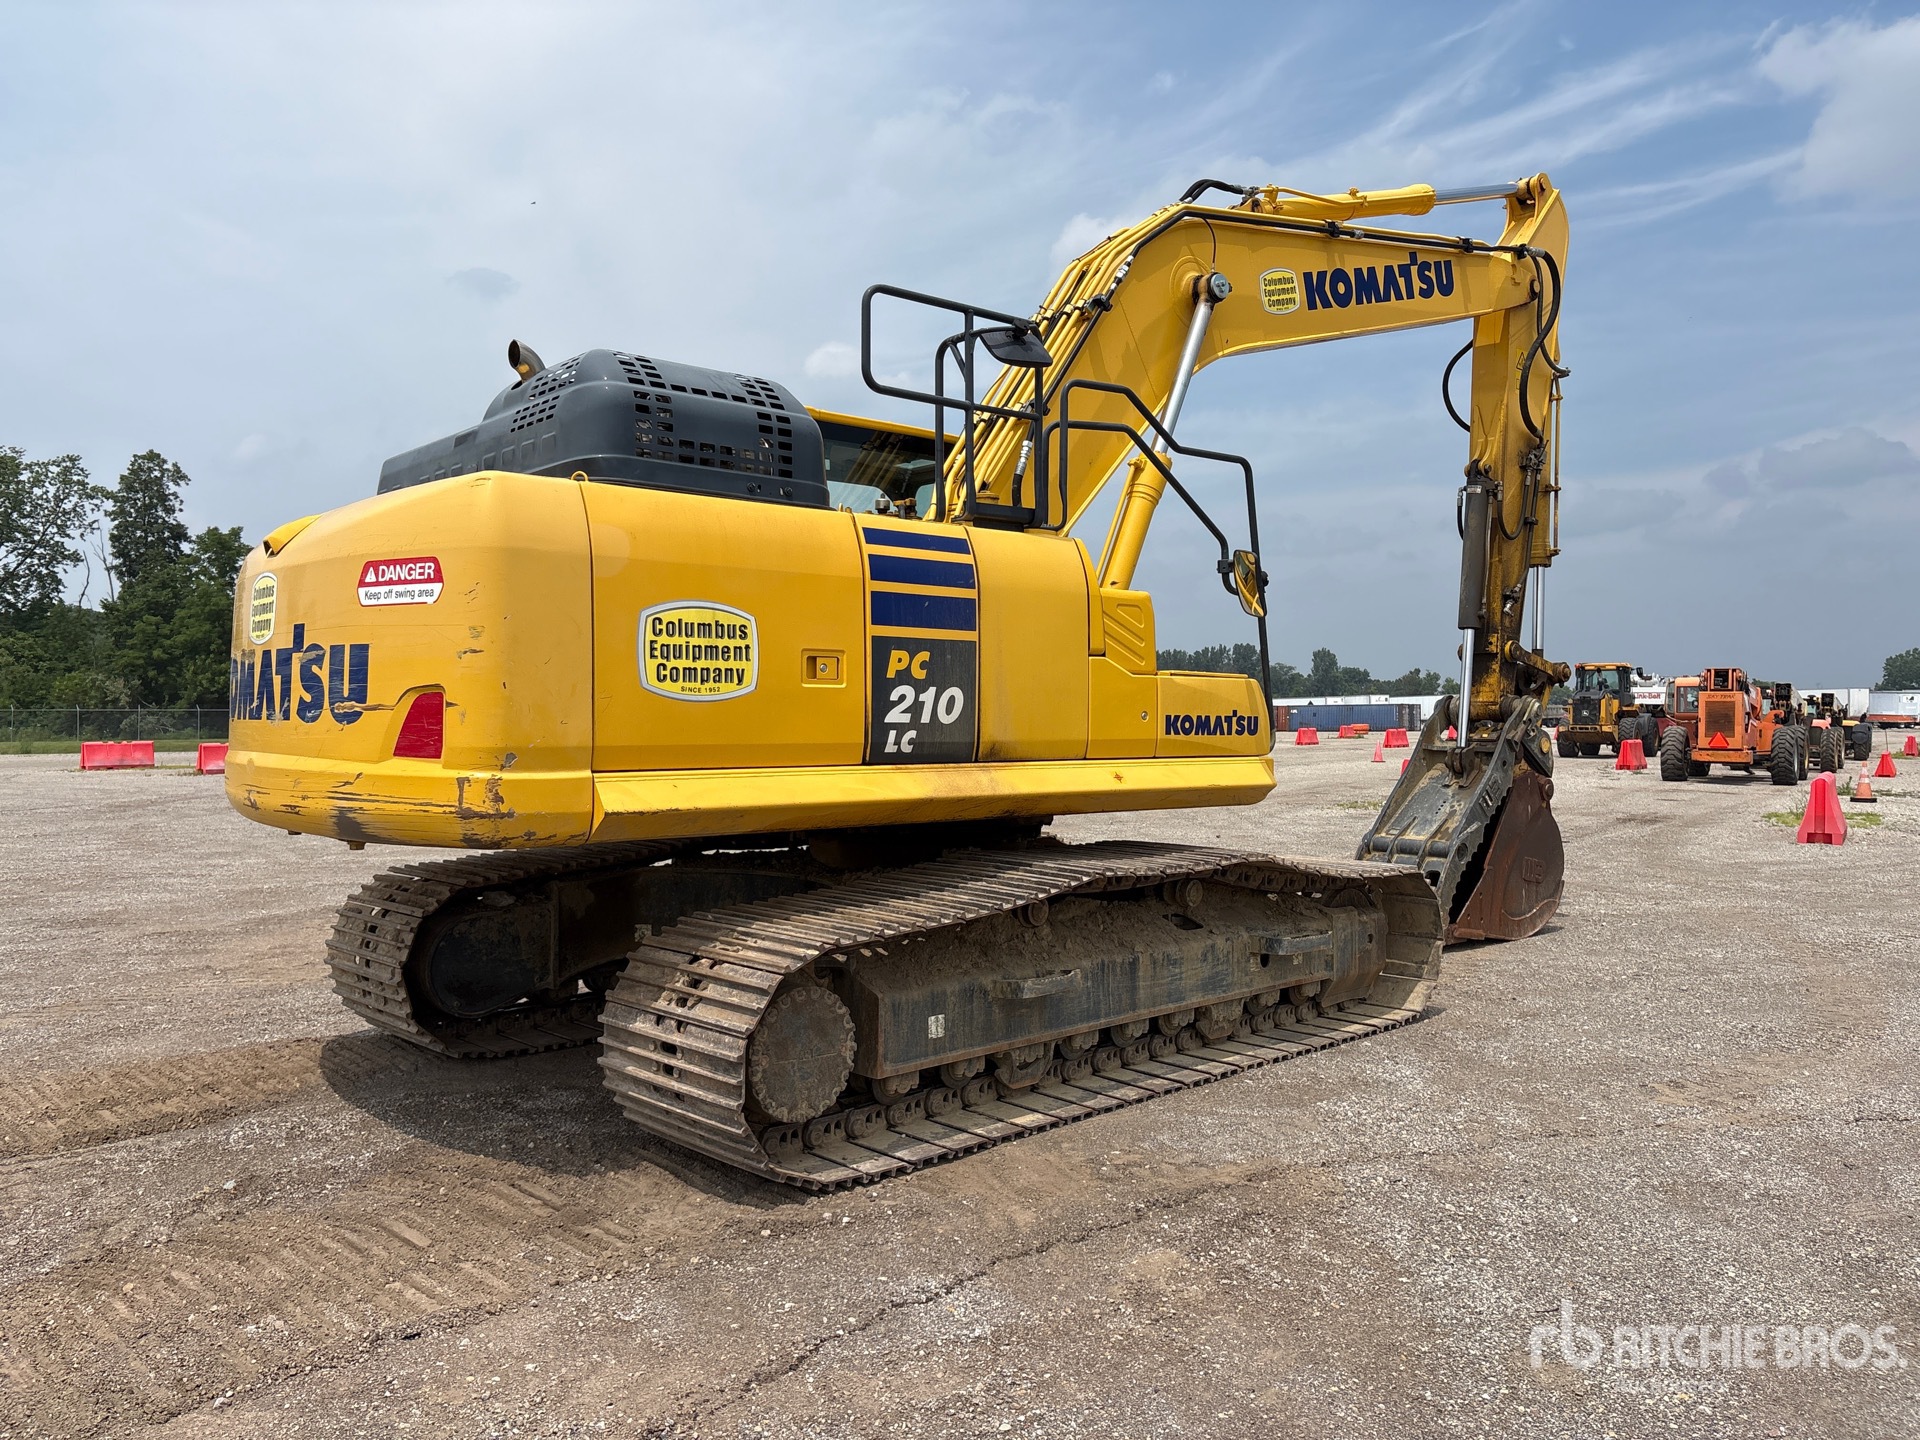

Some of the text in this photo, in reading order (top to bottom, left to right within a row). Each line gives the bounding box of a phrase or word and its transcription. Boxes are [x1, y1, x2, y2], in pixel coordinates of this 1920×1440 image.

[1263, 275, 1295, 287] Columbus
[1264, 286, 1297, 298] Equipment
[1302, 252, 1454, 310] KOMATSU
[1267, 297, 1296, 307] Company
[378, 562, 435, 582] DANGER
[364, 587, 434, 601] Keep off swing area
[652, 617, 748, 640] Columbus
[649, 640, 751, 662] Equipment
[656, 662, 746, 686] Company
[886, 650, 931, 680] PC
[680, 685, 702, 693] SINCE
[884, 685, 964, 724] 210
[1165, 710, 1259, 735] KOMATSU
[884, 730, 917, 753] LC
